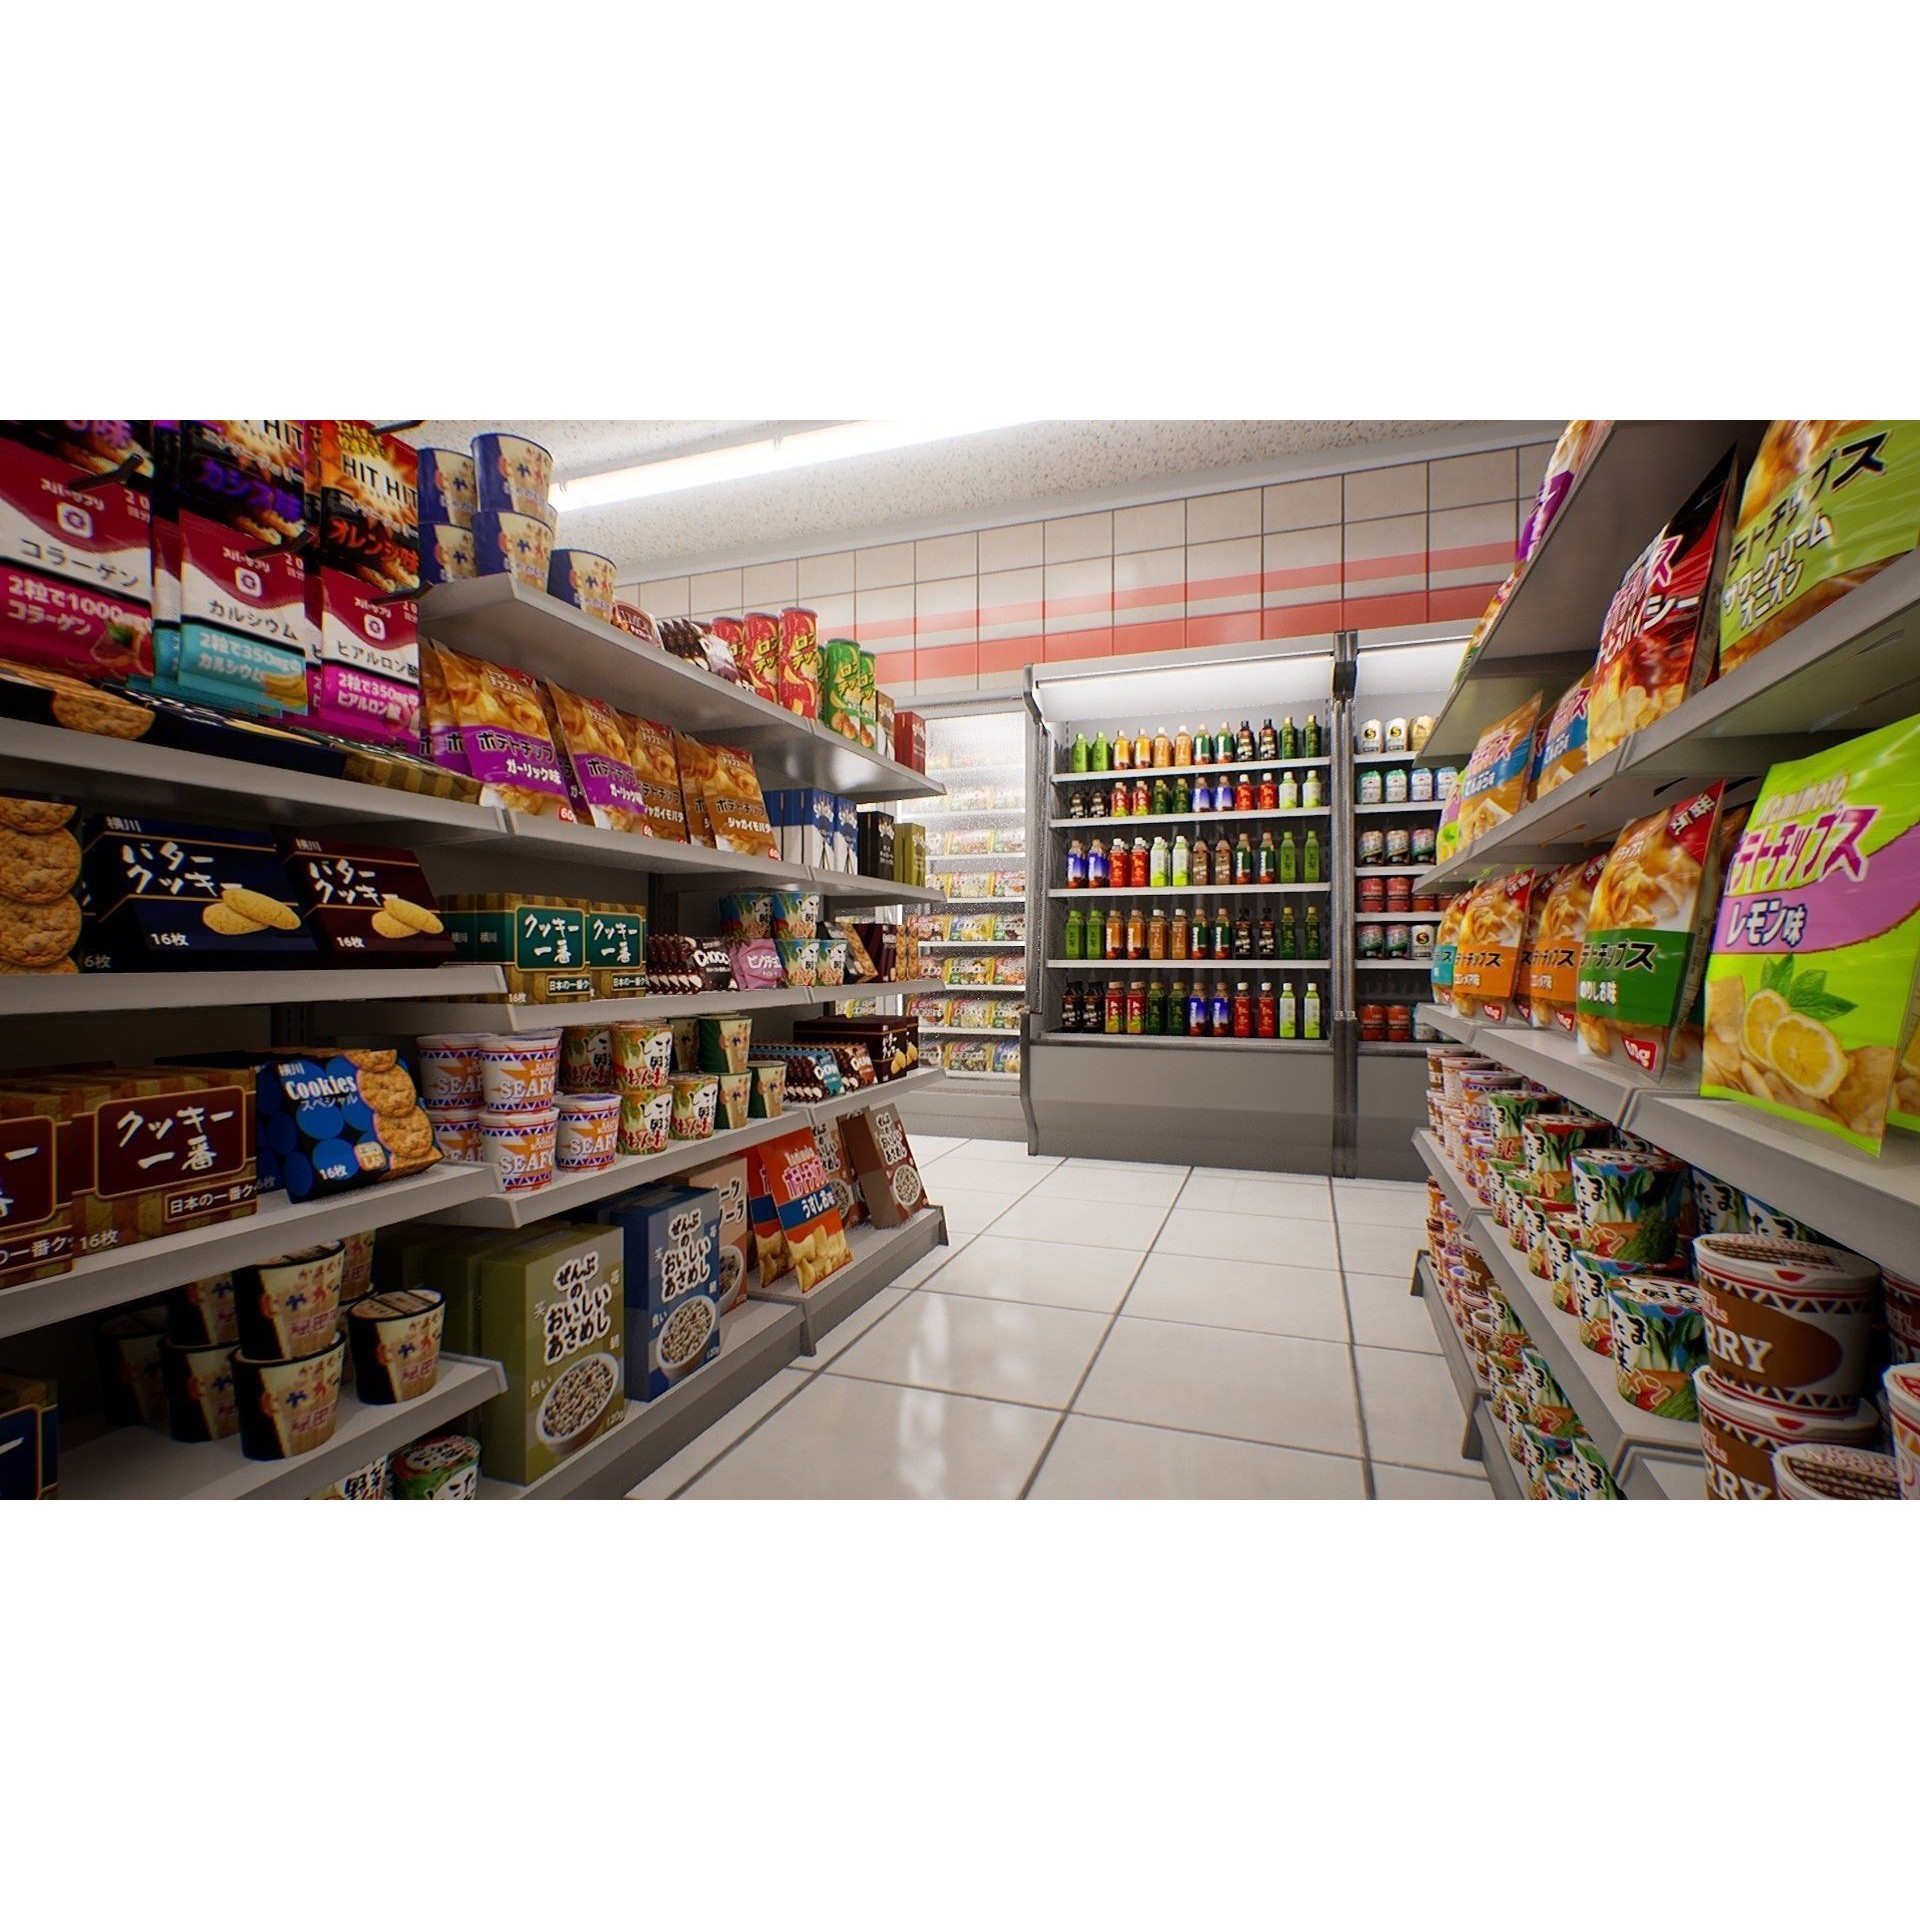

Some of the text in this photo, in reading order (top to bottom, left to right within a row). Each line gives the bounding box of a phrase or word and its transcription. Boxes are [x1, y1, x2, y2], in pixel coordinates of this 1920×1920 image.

[343, 454, 417, 508] HIT HIT
[20, 538, 139, 588] コラーゲン
[328, 517, 419, 575] オレンジ味
[6, 598, 92, 636] コラーゲン
[208, 600, 298, 640] カルシウム
[122, 841, 214, 871] バター
[310, 859, 376, 884] バター
[127, 865, 243, 897] クッキー
[314, 878, 399, 906] クッキー
[524, 913, 580, 939] クッキー
[593, 918, 638, 941] クッキー
[1724, 898, 1808, 947] レモン味
[151, 932, 190, 948] 16枚
[337, 936, 365, 949] 16枚
[285, 1075, 358, 1101] Cookies
[300, 1093, 359, 1113] スペシャル
[117, 1105, 234, 1147] クッキー
[137, 1136, 218, 1172] 一番
[319, 1164, 348, 1180] 16枚
[79, 1230, 119, 1250] 16枚
[669, 1208, 701, 1239] ぜんぶ
[554, 1252, 598, 1289] ぜんぶ
[662, 1238, 711, 1275] おいしい
[662, 1263, 710, 1301] あさめし
[546, 1286, 611, 1333] おいしい
[545, 1314, 611, 1364] あさめし
